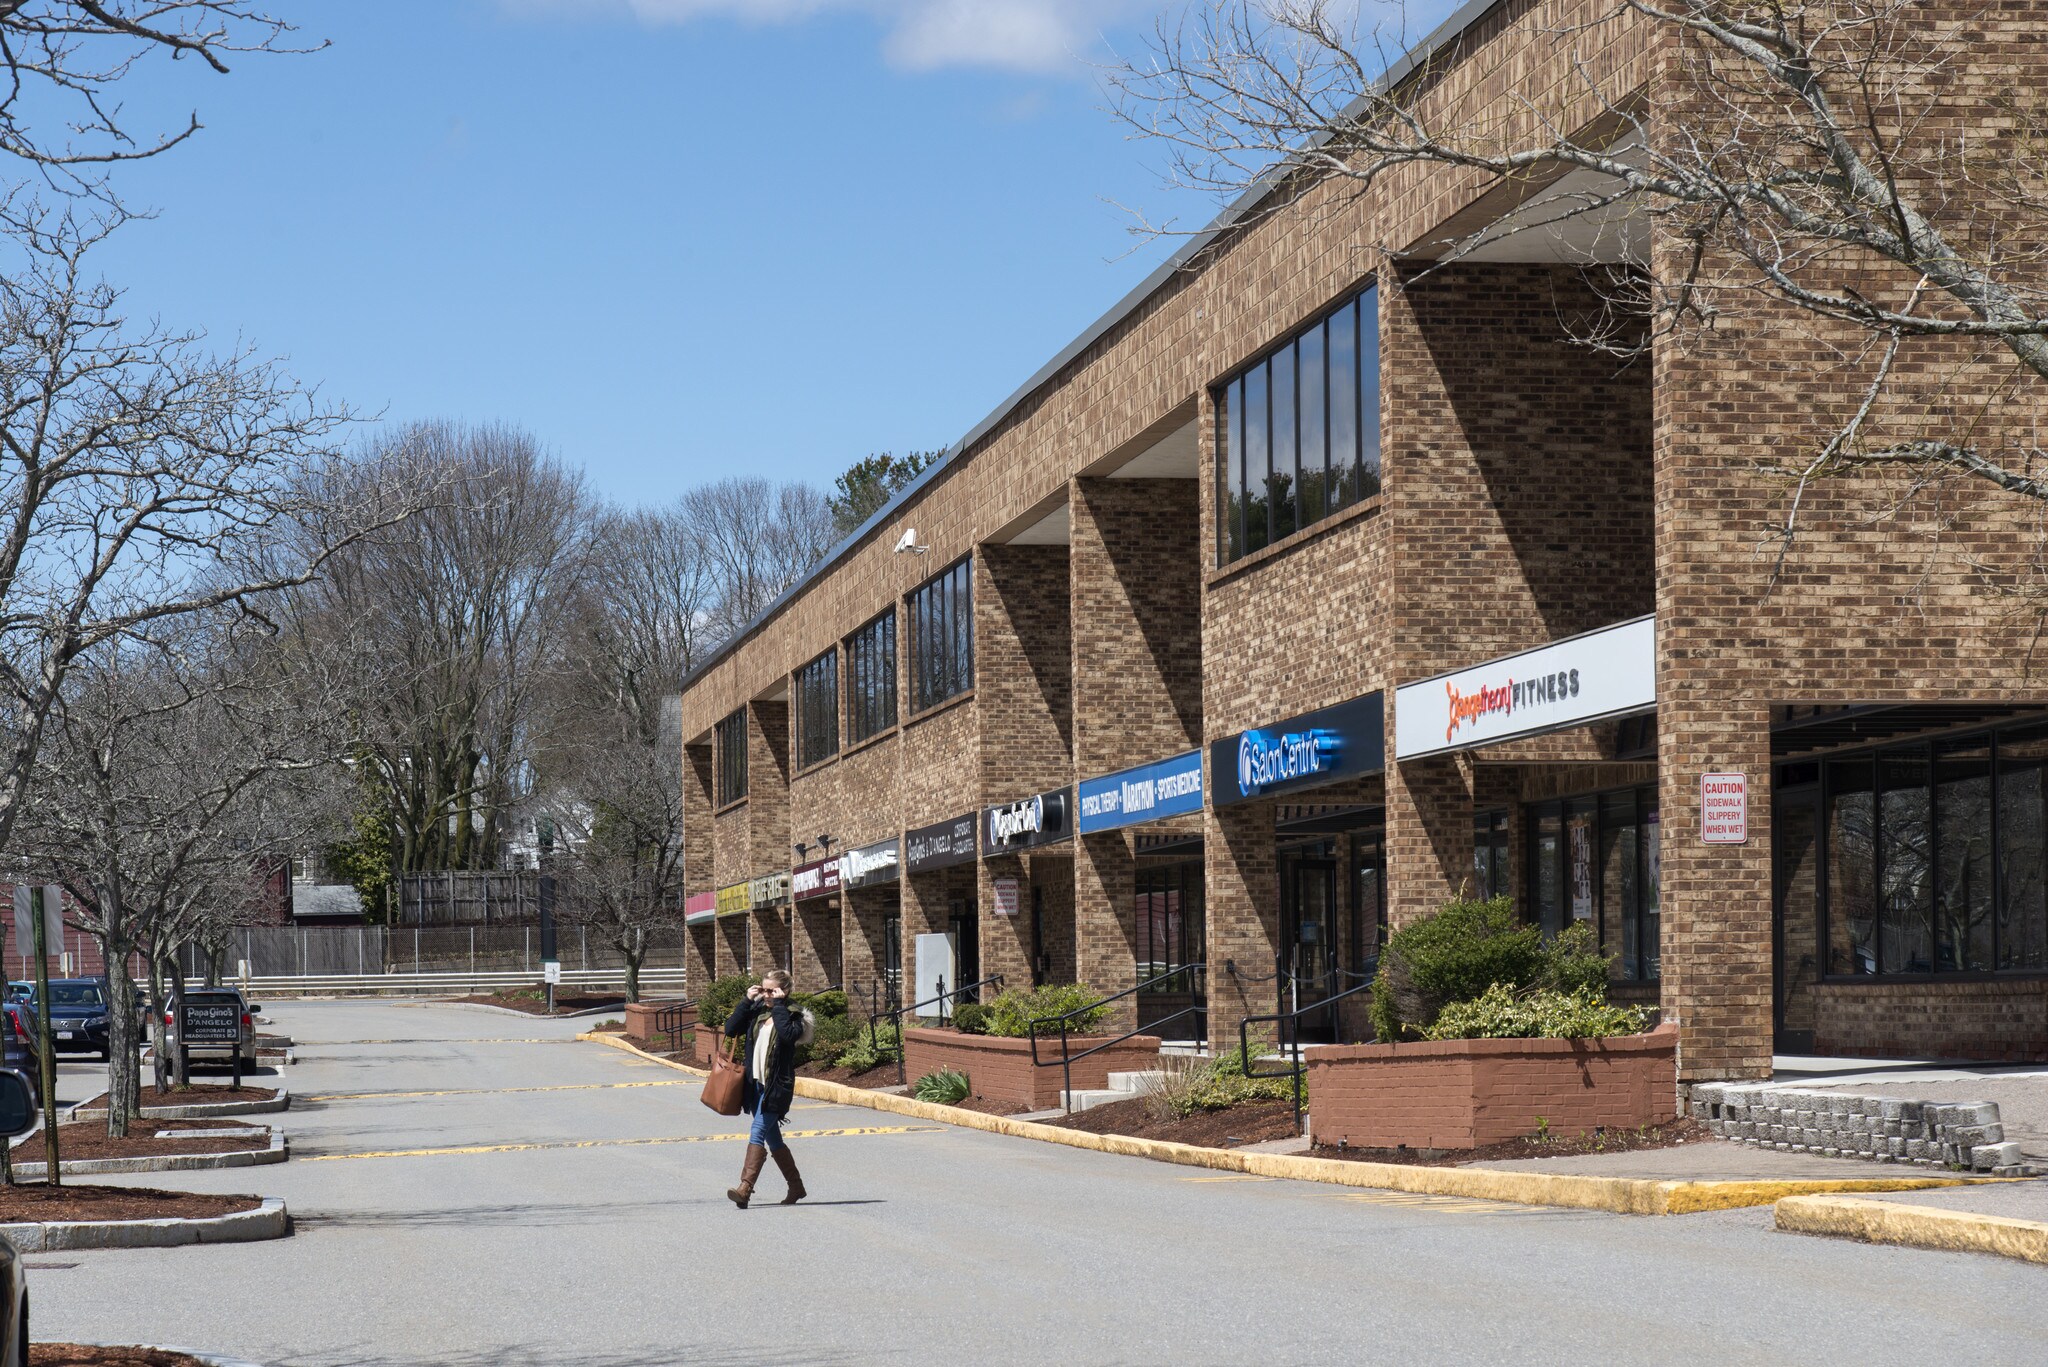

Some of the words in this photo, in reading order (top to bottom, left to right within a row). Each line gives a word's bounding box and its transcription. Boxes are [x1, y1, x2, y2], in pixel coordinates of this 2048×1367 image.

[1513, 669, 1579, 711] FITNESS
[1251, 732, 1320, 786] SalonCentric
[1705, 783, 1743, 794] CAUTION
[1122, 779, 1155, 814] MARATHON
[1157, 775, 1177, 801] SPORTS
[1706, 798, 1742, 807] SIDEWALK
[1707, 811, 1741, 820] SLIPPERY
[1705, 825, 1727, 833] WHEN
[1728, 825, 1743, 833] WET
[187, 1007, 209, 1018] Papa
[209, 1007, 233, 1018] Gino's
